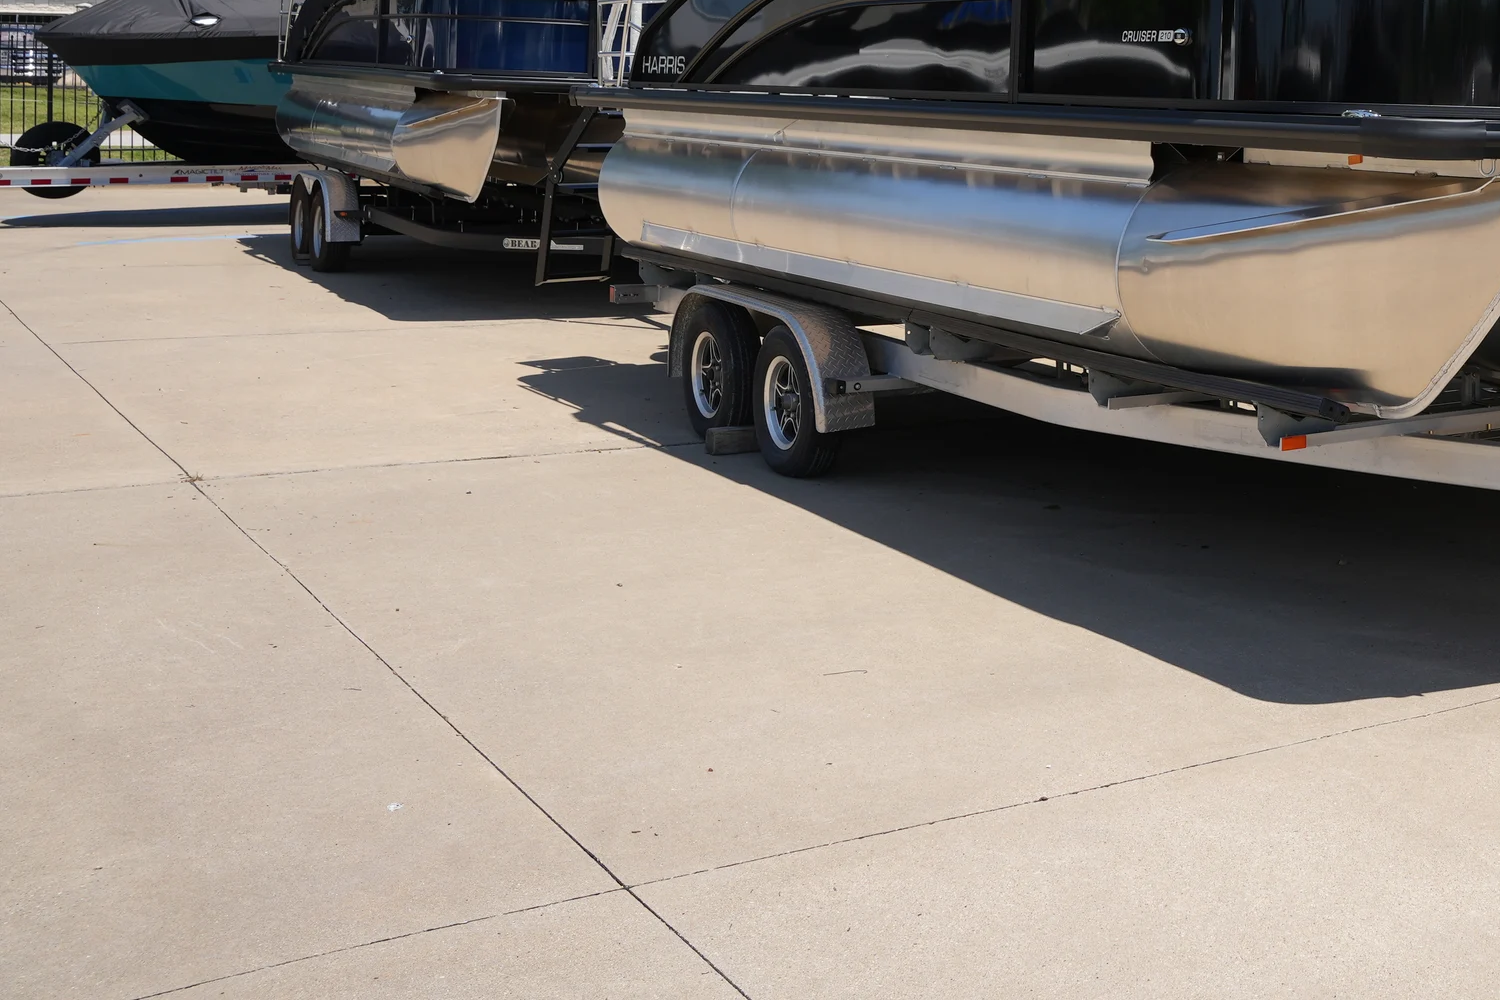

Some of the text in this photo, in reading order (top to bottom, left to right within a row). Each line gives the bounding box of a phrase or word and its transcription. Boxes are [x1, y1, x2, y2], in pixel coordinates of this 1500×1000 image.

[1121, 30, 1171, 42] CRUISER 210
[642, 56, 686, 75] HARRIS
